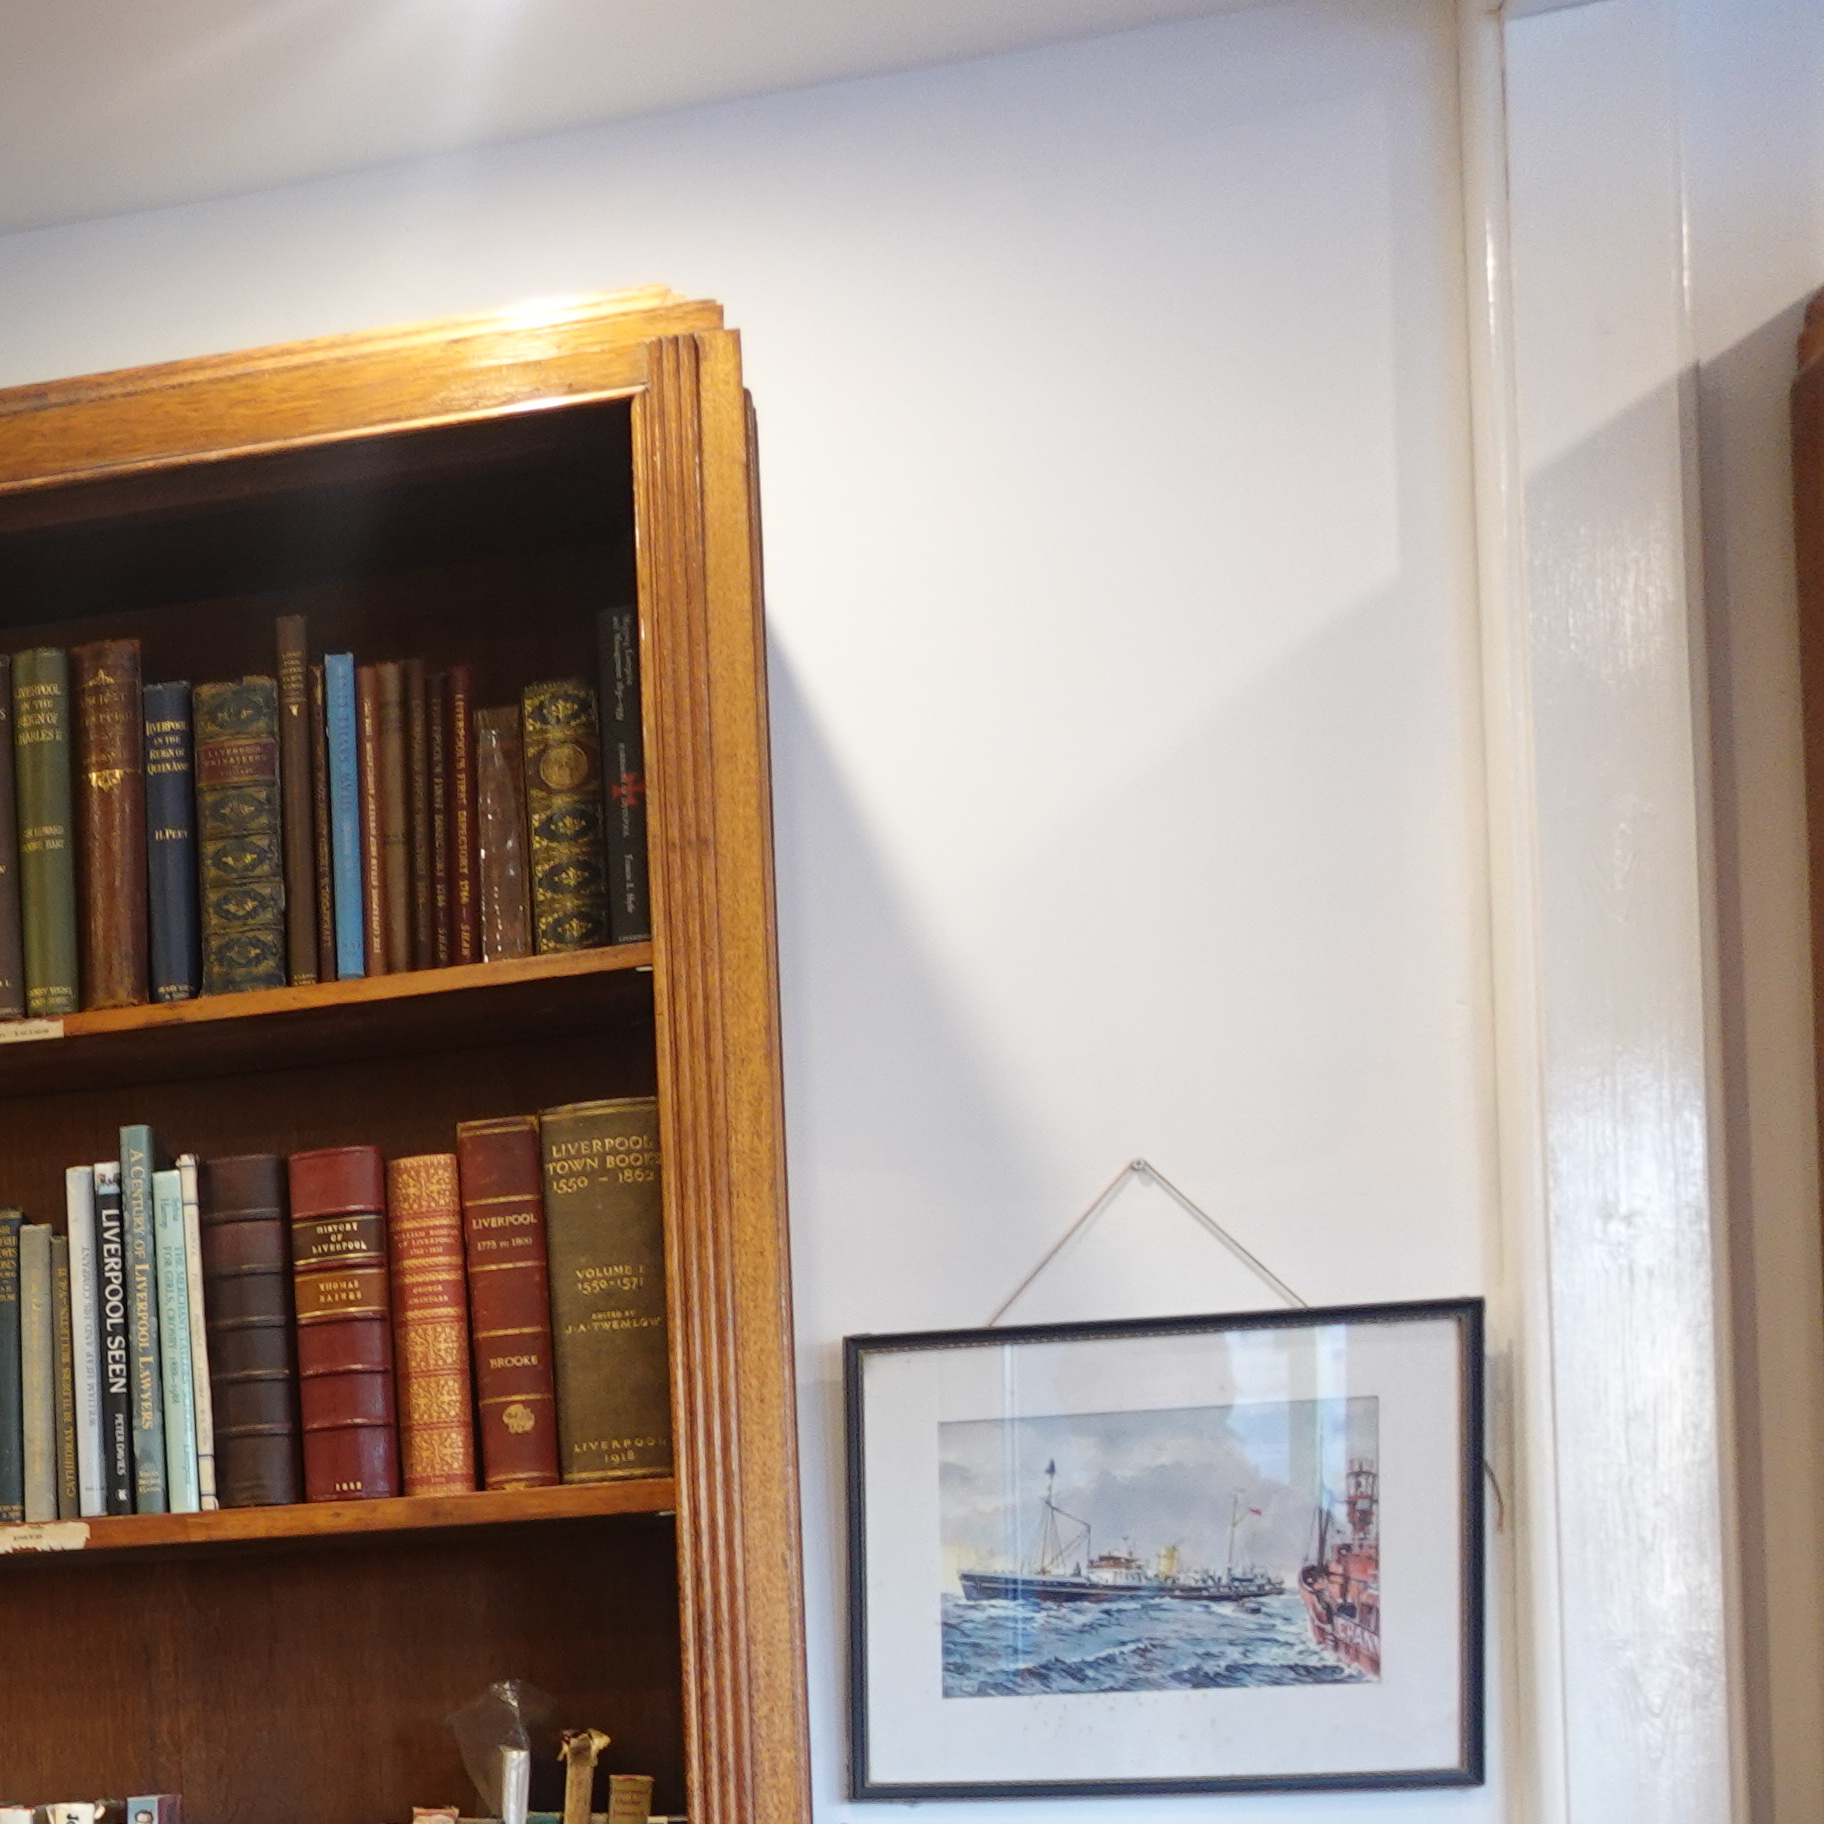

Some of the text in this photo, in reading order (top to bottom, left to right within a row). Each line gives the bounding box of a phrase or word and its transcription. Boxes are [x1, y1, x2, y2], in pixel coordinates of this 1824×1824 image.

[546, 1159, 600, 1175] TOWN
[472, 1216, 538, 1230] LIVERPOOL
[101, 1209, 127, 1394] LIVERPOOL SEEN
[134, 1238, 154, 1430] OF LAWYERS
[490, 1355, 539, 1369] BROOKE
